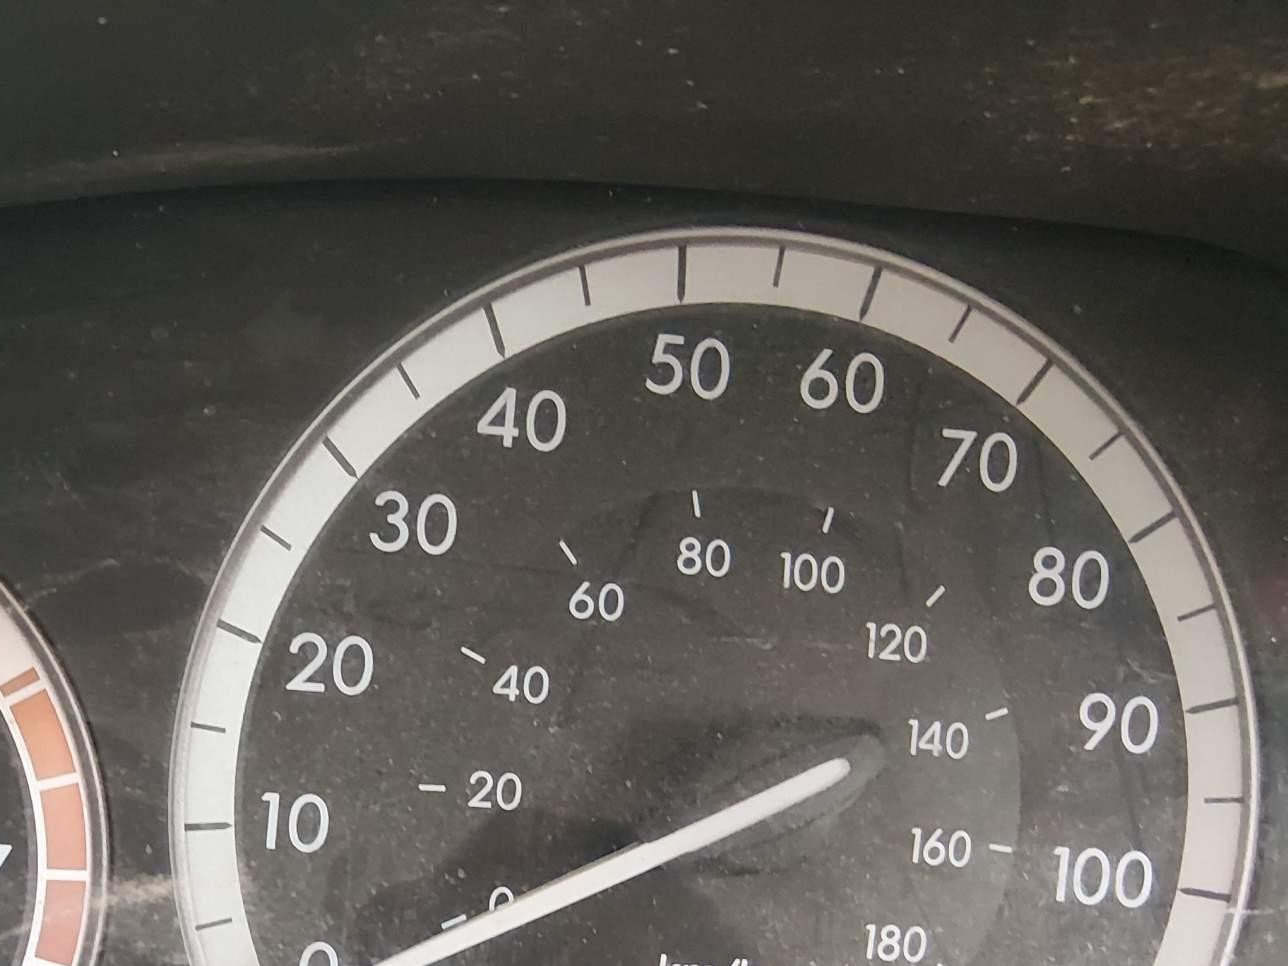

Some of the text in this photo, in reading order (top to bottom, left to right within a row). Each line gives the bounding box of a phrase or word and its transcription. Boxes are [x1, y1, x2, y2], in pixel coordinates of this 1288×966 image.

[645, 334, 730, 400] 50
[800, 349, 884, 413] 60
[477, 387, 567, 452] 40
[938, 428, 1017, 492] 70
[369, 490, 457, 555] 30
[677, 537, 731, 578] 80
[780, 551, 845, 594] 100
[1028, 547, 1109, 610] 80
[569, 581, 624, 621] 60
[286, 632, 373, 696] 20
[867, 622, 927, 663] 120
[492, 665, 550, 704] 40
[908, 719, 969, 759] 140
[1079, 693, 1158, 754] 90
[468, 770, 522, 811] 20
[261, 792, 329, 853] 10
[911, 827, 972, 868] 160
[1054, 847, 1153, 908] 100
[865, 924, 926, 963] 180
